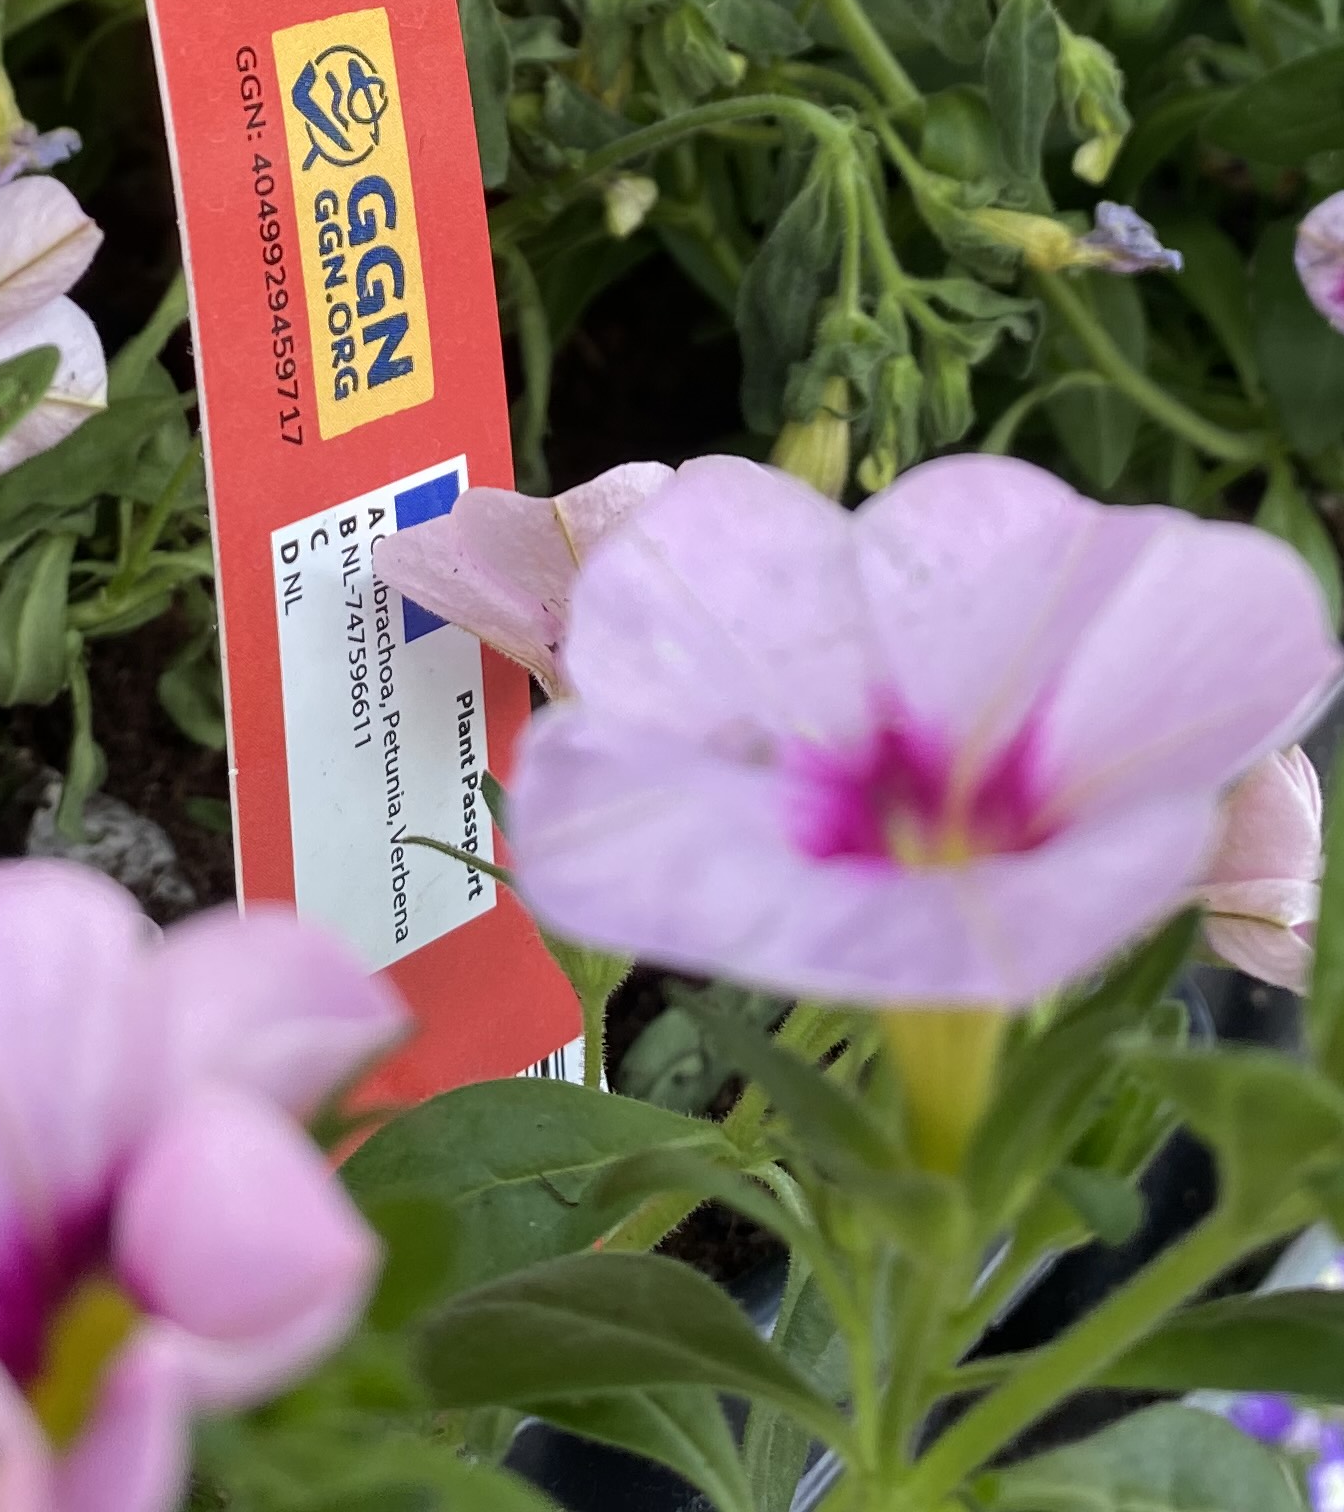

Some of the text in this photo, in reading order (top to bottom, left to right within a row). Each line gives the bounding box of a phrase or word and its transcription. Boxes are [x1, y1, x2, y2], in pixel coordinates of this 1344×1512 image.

[235, 45, 304, 447] GGN: 4049929459717
[314, 189, 359, 401] GGN.ORG
[347, 174, 415, 389] GGN
[310, 528, 329, 552] C
[367, 507, 386, 528] A
[280, 539, 304, 617] D NL
[338, 515, 373, 749] B NL-747596611
[378, 710, 402, 826] Petunia,
[456, 689, 478, 770] Plant
[389, 825, 410, 945] Verbena
